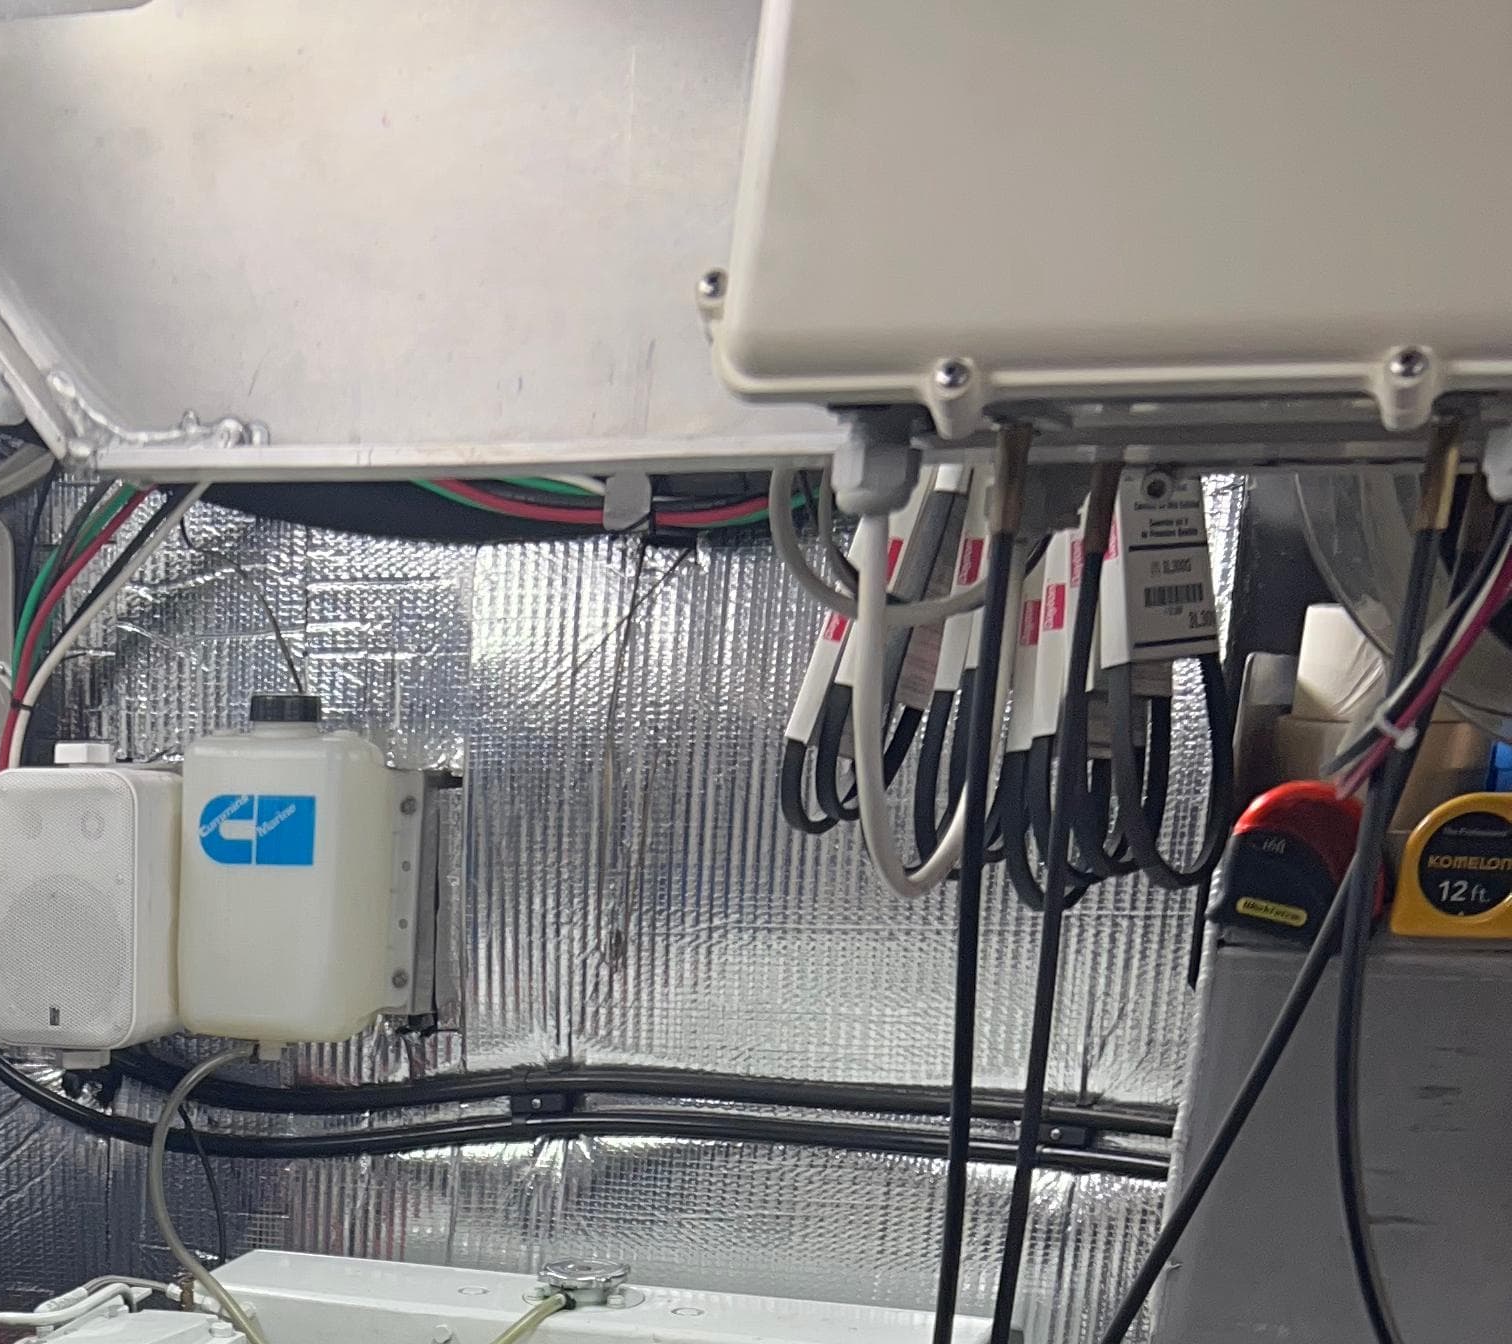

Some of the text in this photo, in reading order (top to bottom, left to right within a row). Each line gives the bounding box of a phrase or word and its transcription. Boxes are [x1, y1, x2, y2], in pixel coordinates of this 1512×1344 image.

[198, 794, 297, 838] Cummins Marine
[1438, 880, 1469, 902] 12
